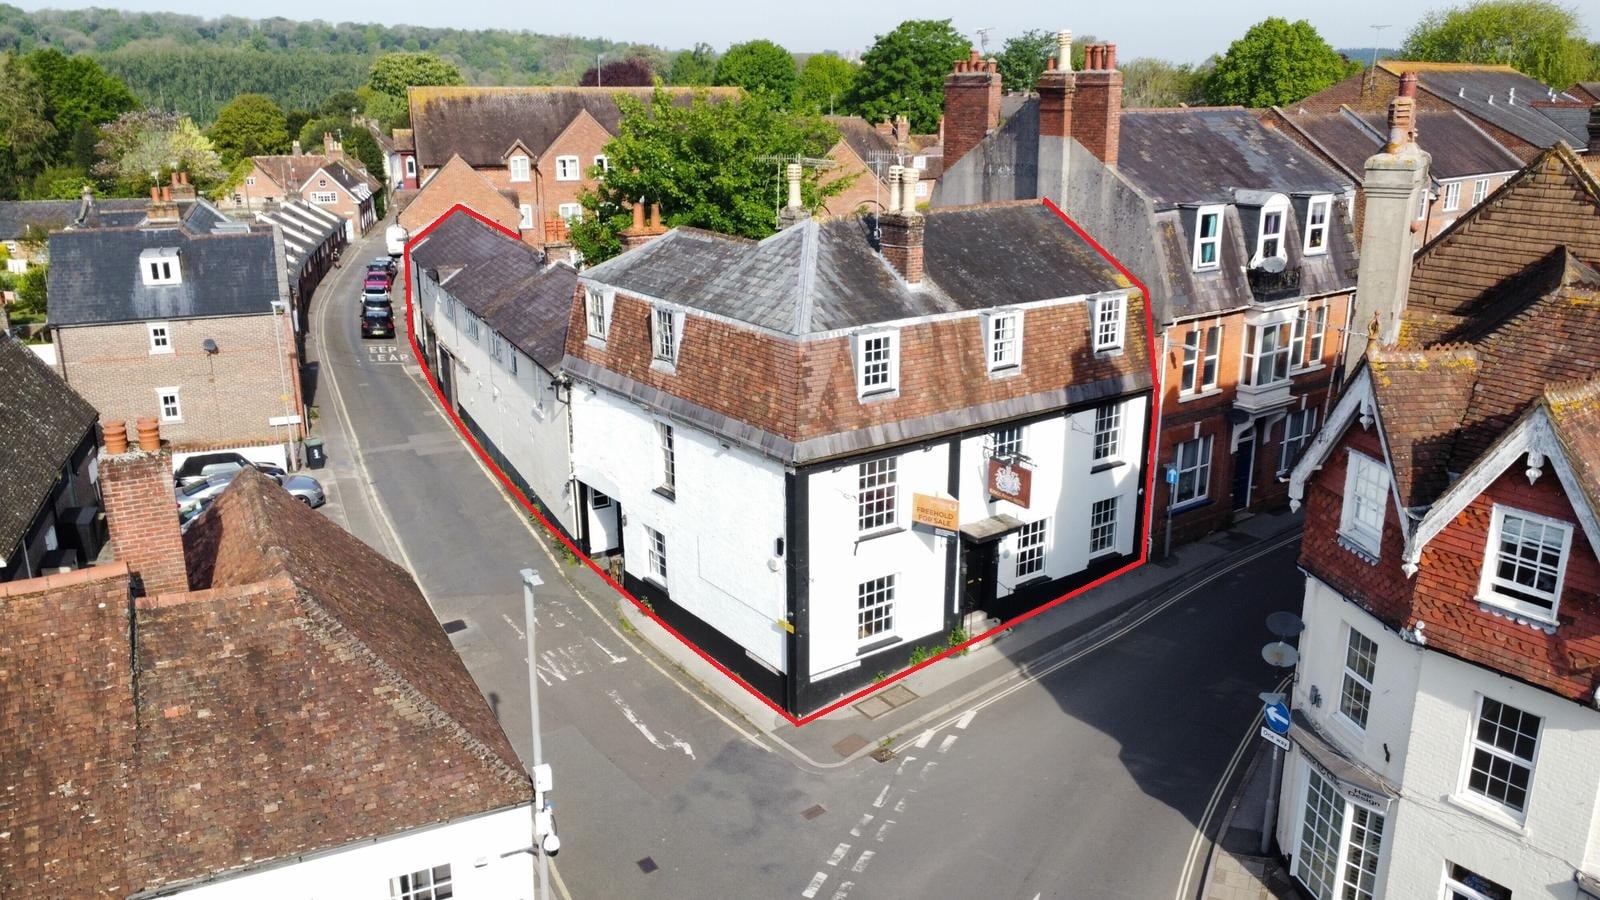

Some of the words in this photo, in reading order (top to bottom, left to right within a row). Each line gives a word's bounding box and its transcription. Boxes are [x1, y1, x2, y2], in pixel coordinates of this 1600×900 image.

[917, 506, 954, 520] FREEHOLD
[919, 514, 933, 522] FOR
[933, 518, 953, 528] SALE
[1347, 790, 1381, 807] Design
[1354, 788, 1374, 799] Hair
